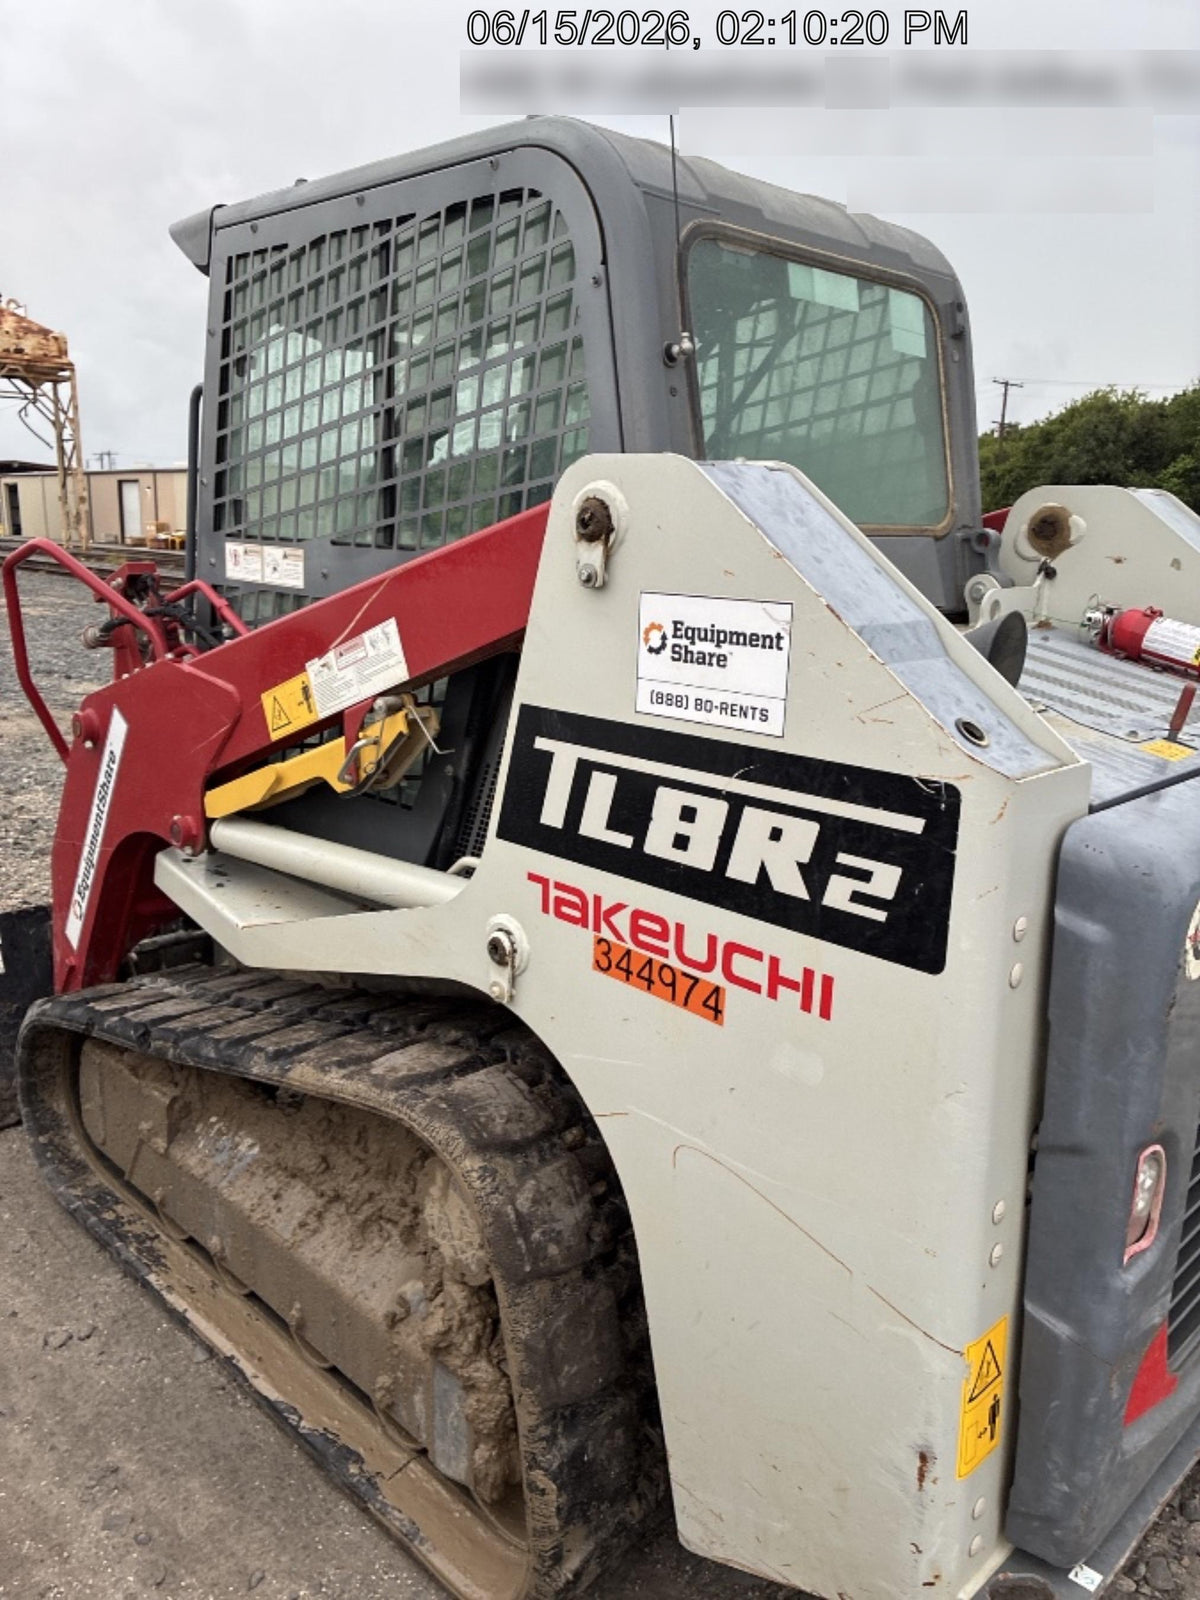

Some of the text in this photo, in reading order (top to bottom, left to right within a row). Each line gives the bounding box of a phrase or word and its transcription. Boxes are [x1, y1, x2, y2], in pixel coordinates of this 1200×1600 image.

[671, 620, 784, 651] Equipment
[671, 643, 728, 668] Share
[649, 689, 769, 722] (888) 80-RENTS
[75, 750, 117, 902] EquipmentShare
[594, 937, 725, 1023] 344974
